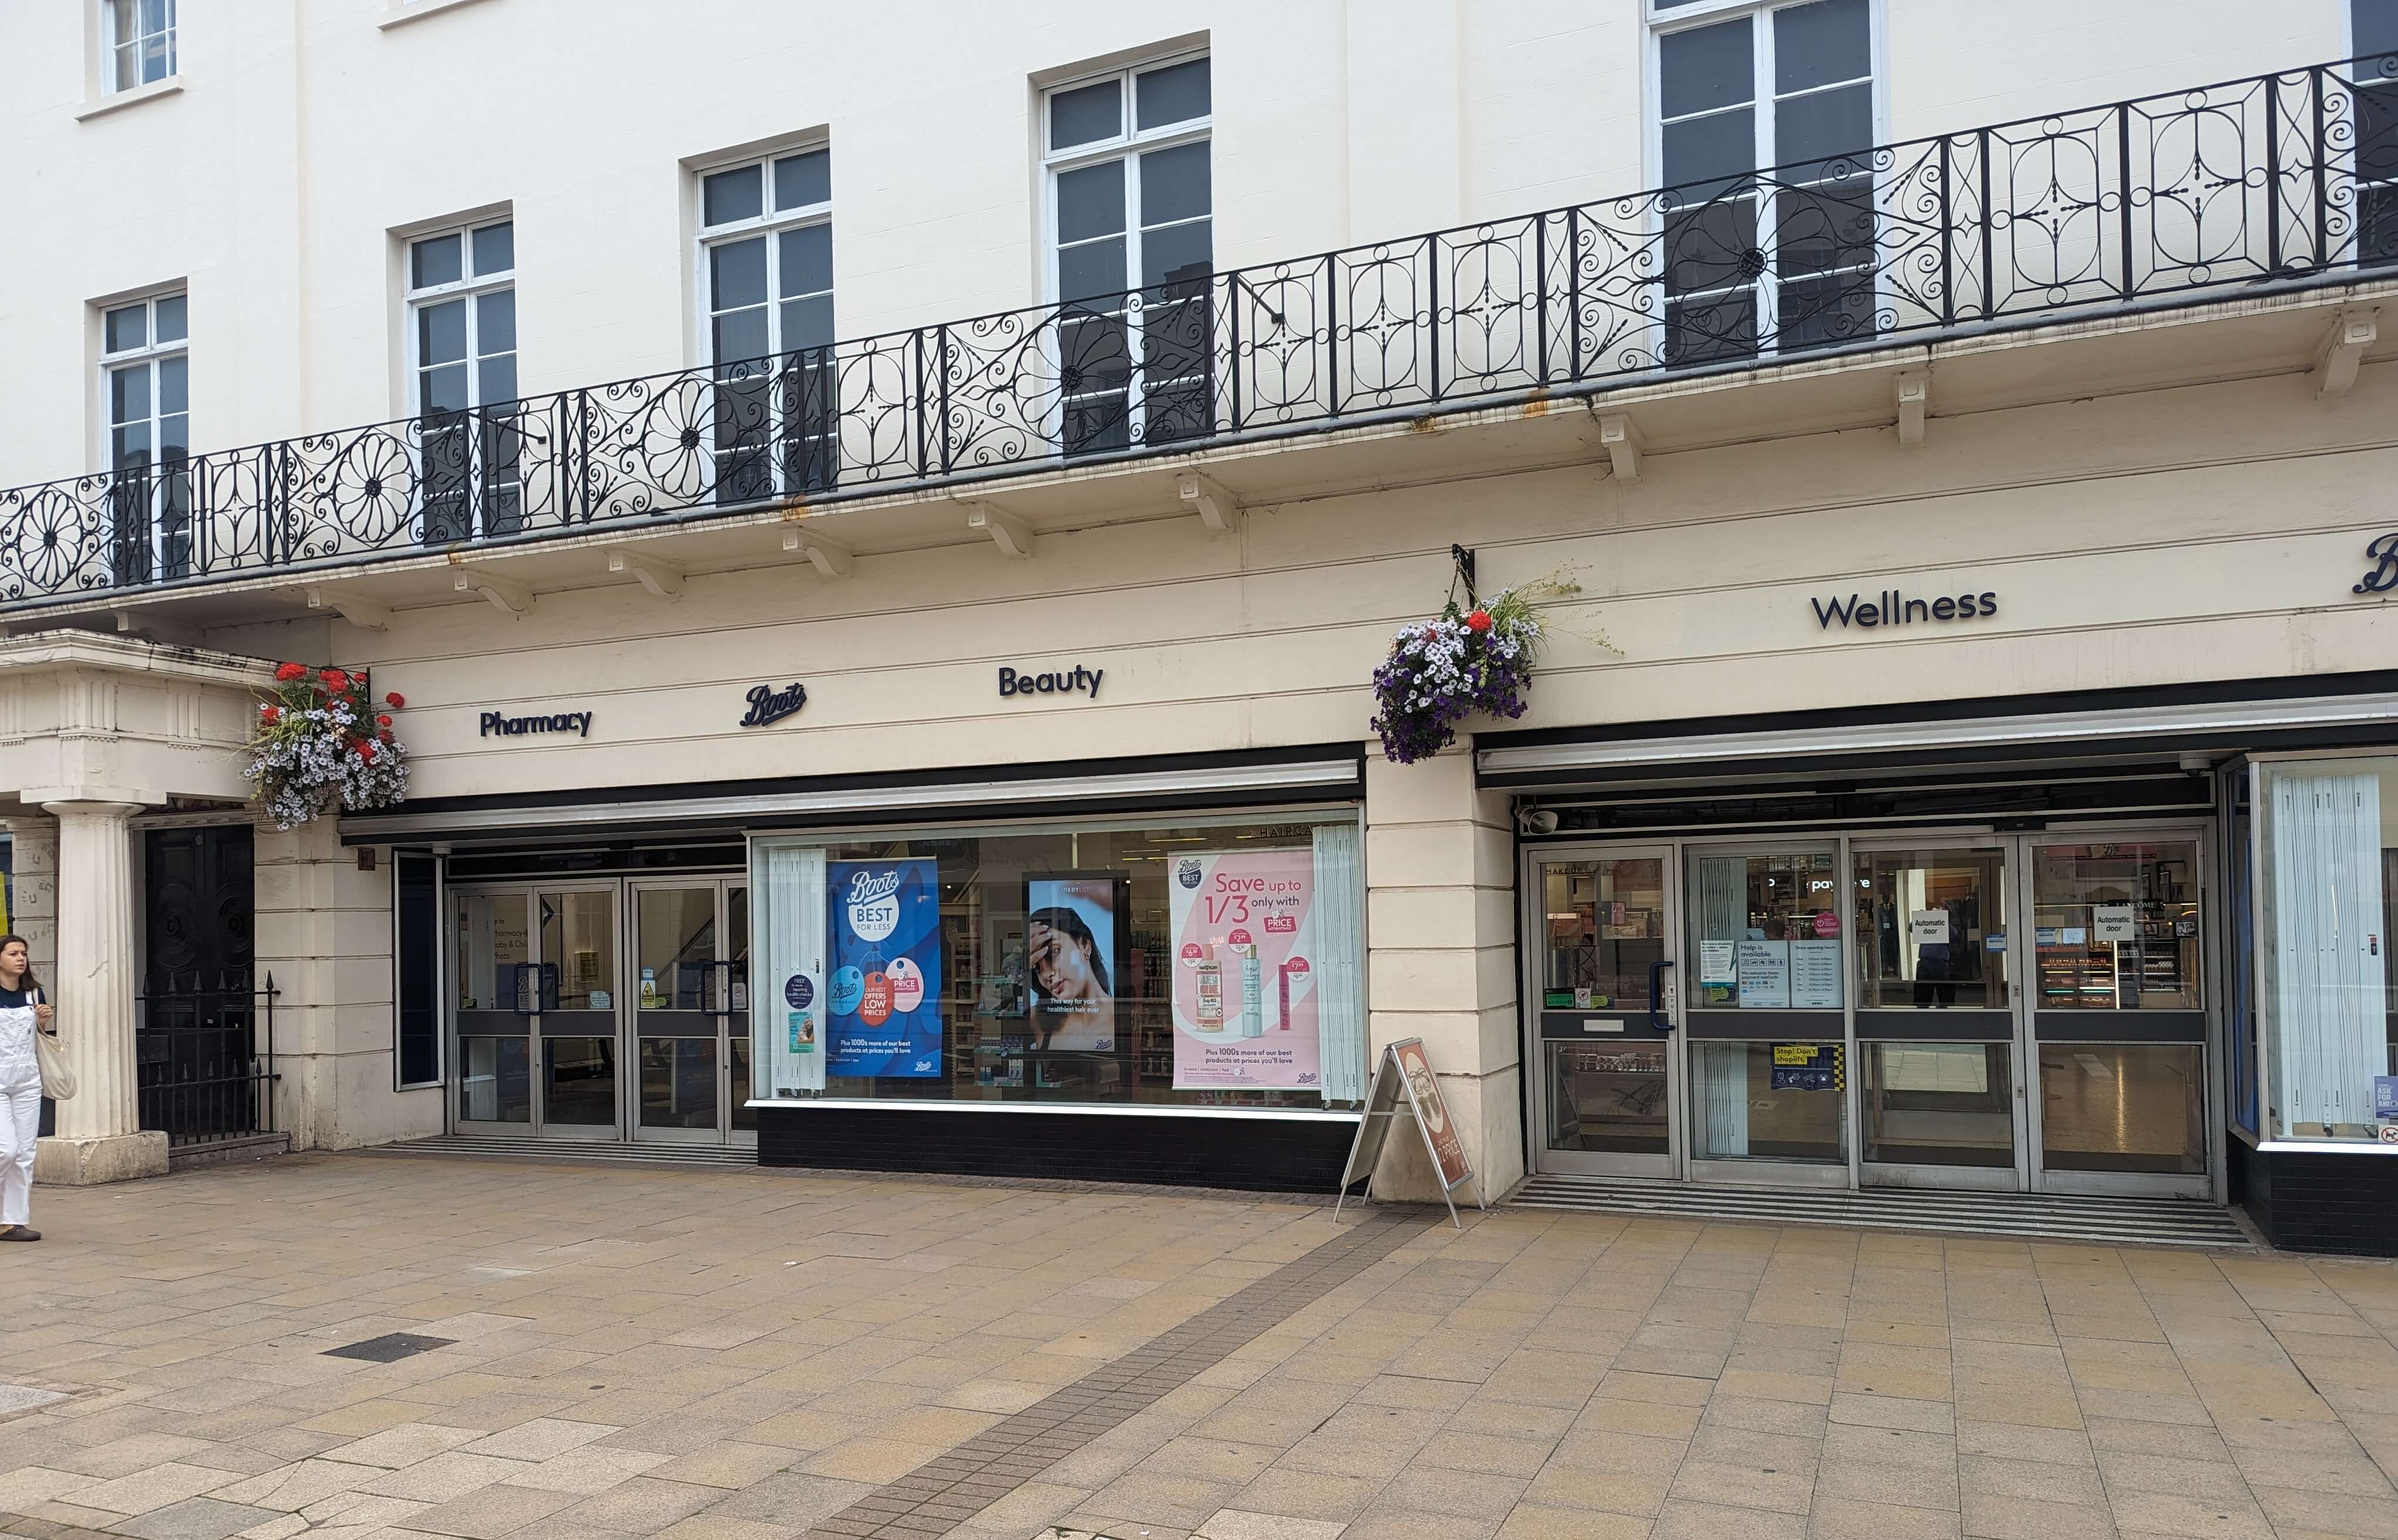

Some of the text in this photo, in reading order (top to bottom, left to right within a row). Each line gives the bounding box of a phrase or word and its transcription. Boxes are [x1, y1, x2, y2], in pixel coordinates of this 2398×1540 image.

[1811, 589, 1997, 630] Wellness
[999, 664, 1103, 699] Beauty
[739, 682, 807, 727] Boots
[480, 710, 592, 737] Pharmacy
[1260, 825, 1320, 837] HAIRCA
[1178, 859, 1201, 874] Boots
[846, 870, 899, 904] Boots
[1215, 873, 1301, 894] Save up to
[1251, 895, 1299, 909] only with
[857, 908, 893, 922] BEST
[1205, 895, 1249, 924] 1/3
[1268, 918, 1291, 927] PRICE
[1200, 975, 1218, 984] CLEAN
[832, 983, 857, 999] Boots
[865, 1000, 886, 1009] LOW
[1095, 1039, 1113, 1050] Boots
[914, 1061, 932, 1072] Boots
[1297, 1072, 1317, 1083] Boots
